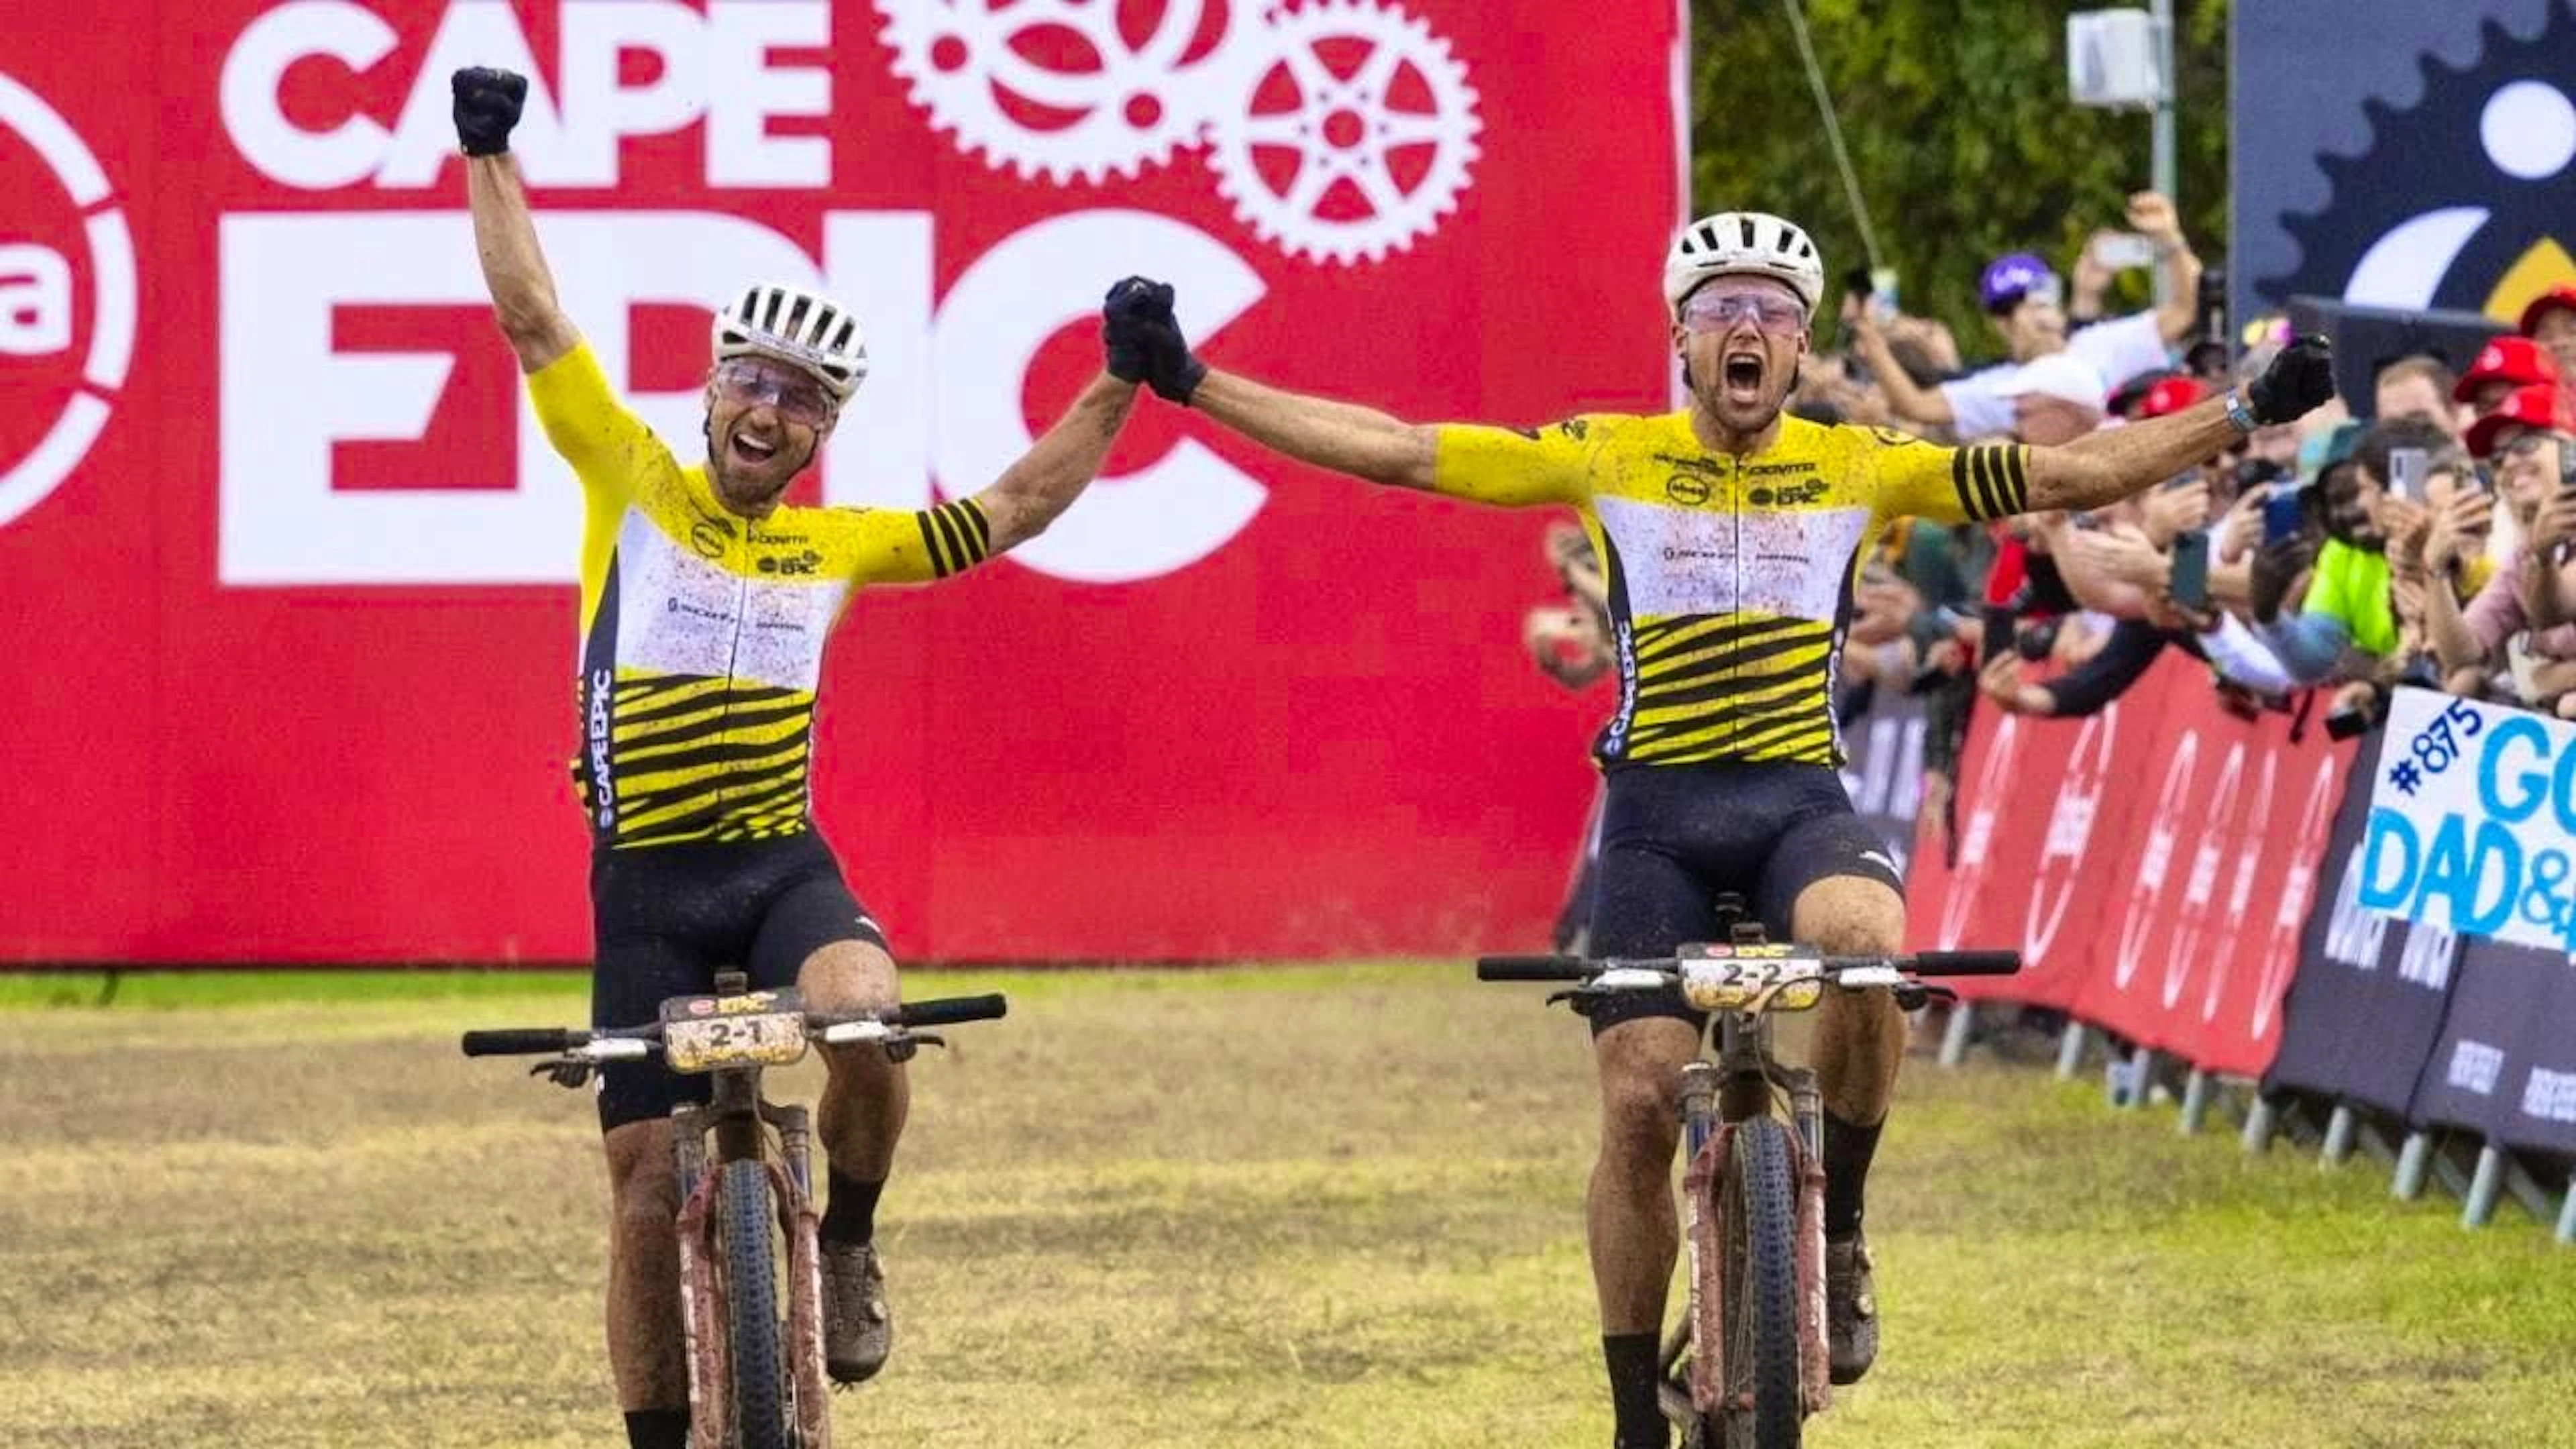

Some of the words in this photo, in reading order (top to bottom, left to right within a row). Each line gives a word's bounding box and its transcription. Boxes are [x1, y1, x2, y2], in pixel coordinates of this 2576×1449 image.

[219, 0, 831, 189] CAPE
[219, 210, 1270, 585] EPIC
[2389, 698, 2483, 796] #875
[1723, 963, 1782, 987] 2-2
[710, 1020, 761, 1046] 2-1
